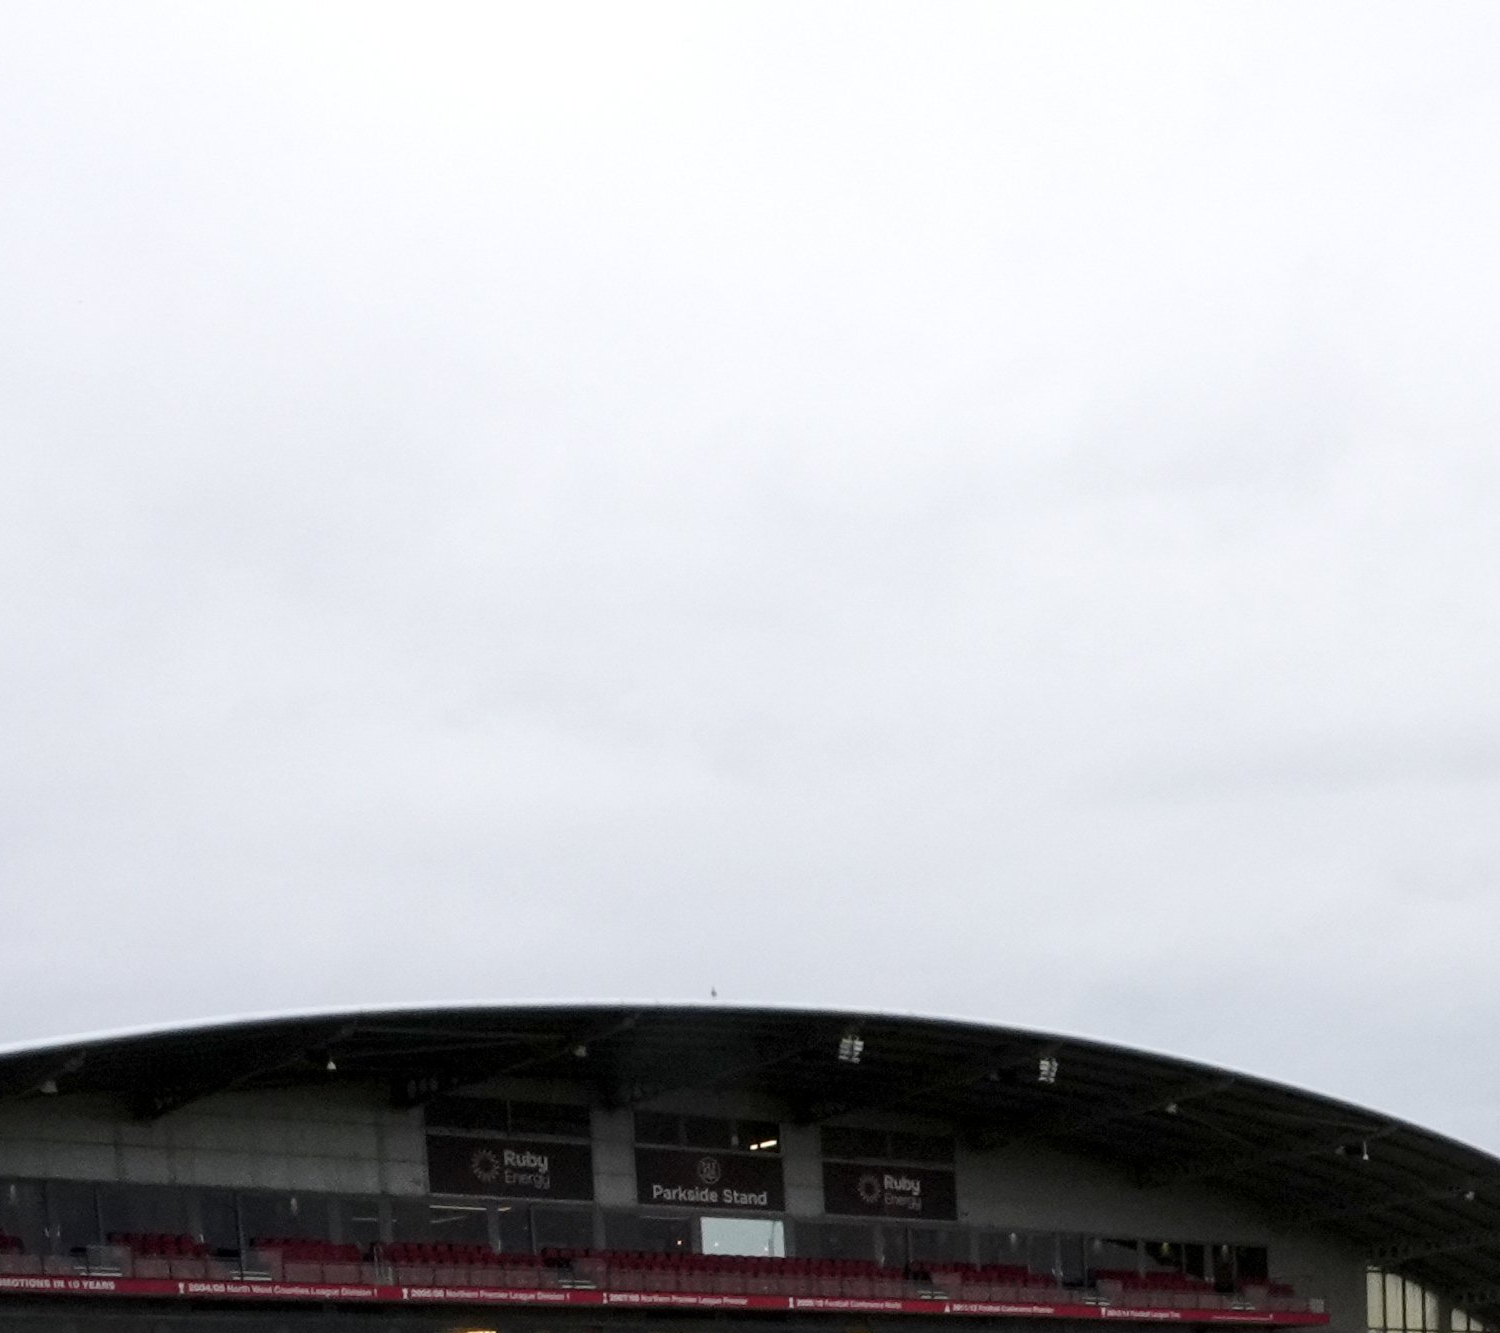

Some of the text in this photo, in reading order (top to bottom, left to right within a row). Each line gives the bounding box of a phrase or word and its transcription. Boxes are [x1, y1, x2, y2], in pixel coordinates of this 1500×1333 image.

[503, 1149, 549, 1174] Ruby
[504, 1170, 551, 1190] Energy
[884, 1174, 921, 1196] Ruby
[652, 1183, 768, 1206] Parkside Stand
[82, 1280, 116, 1291] YEARS
